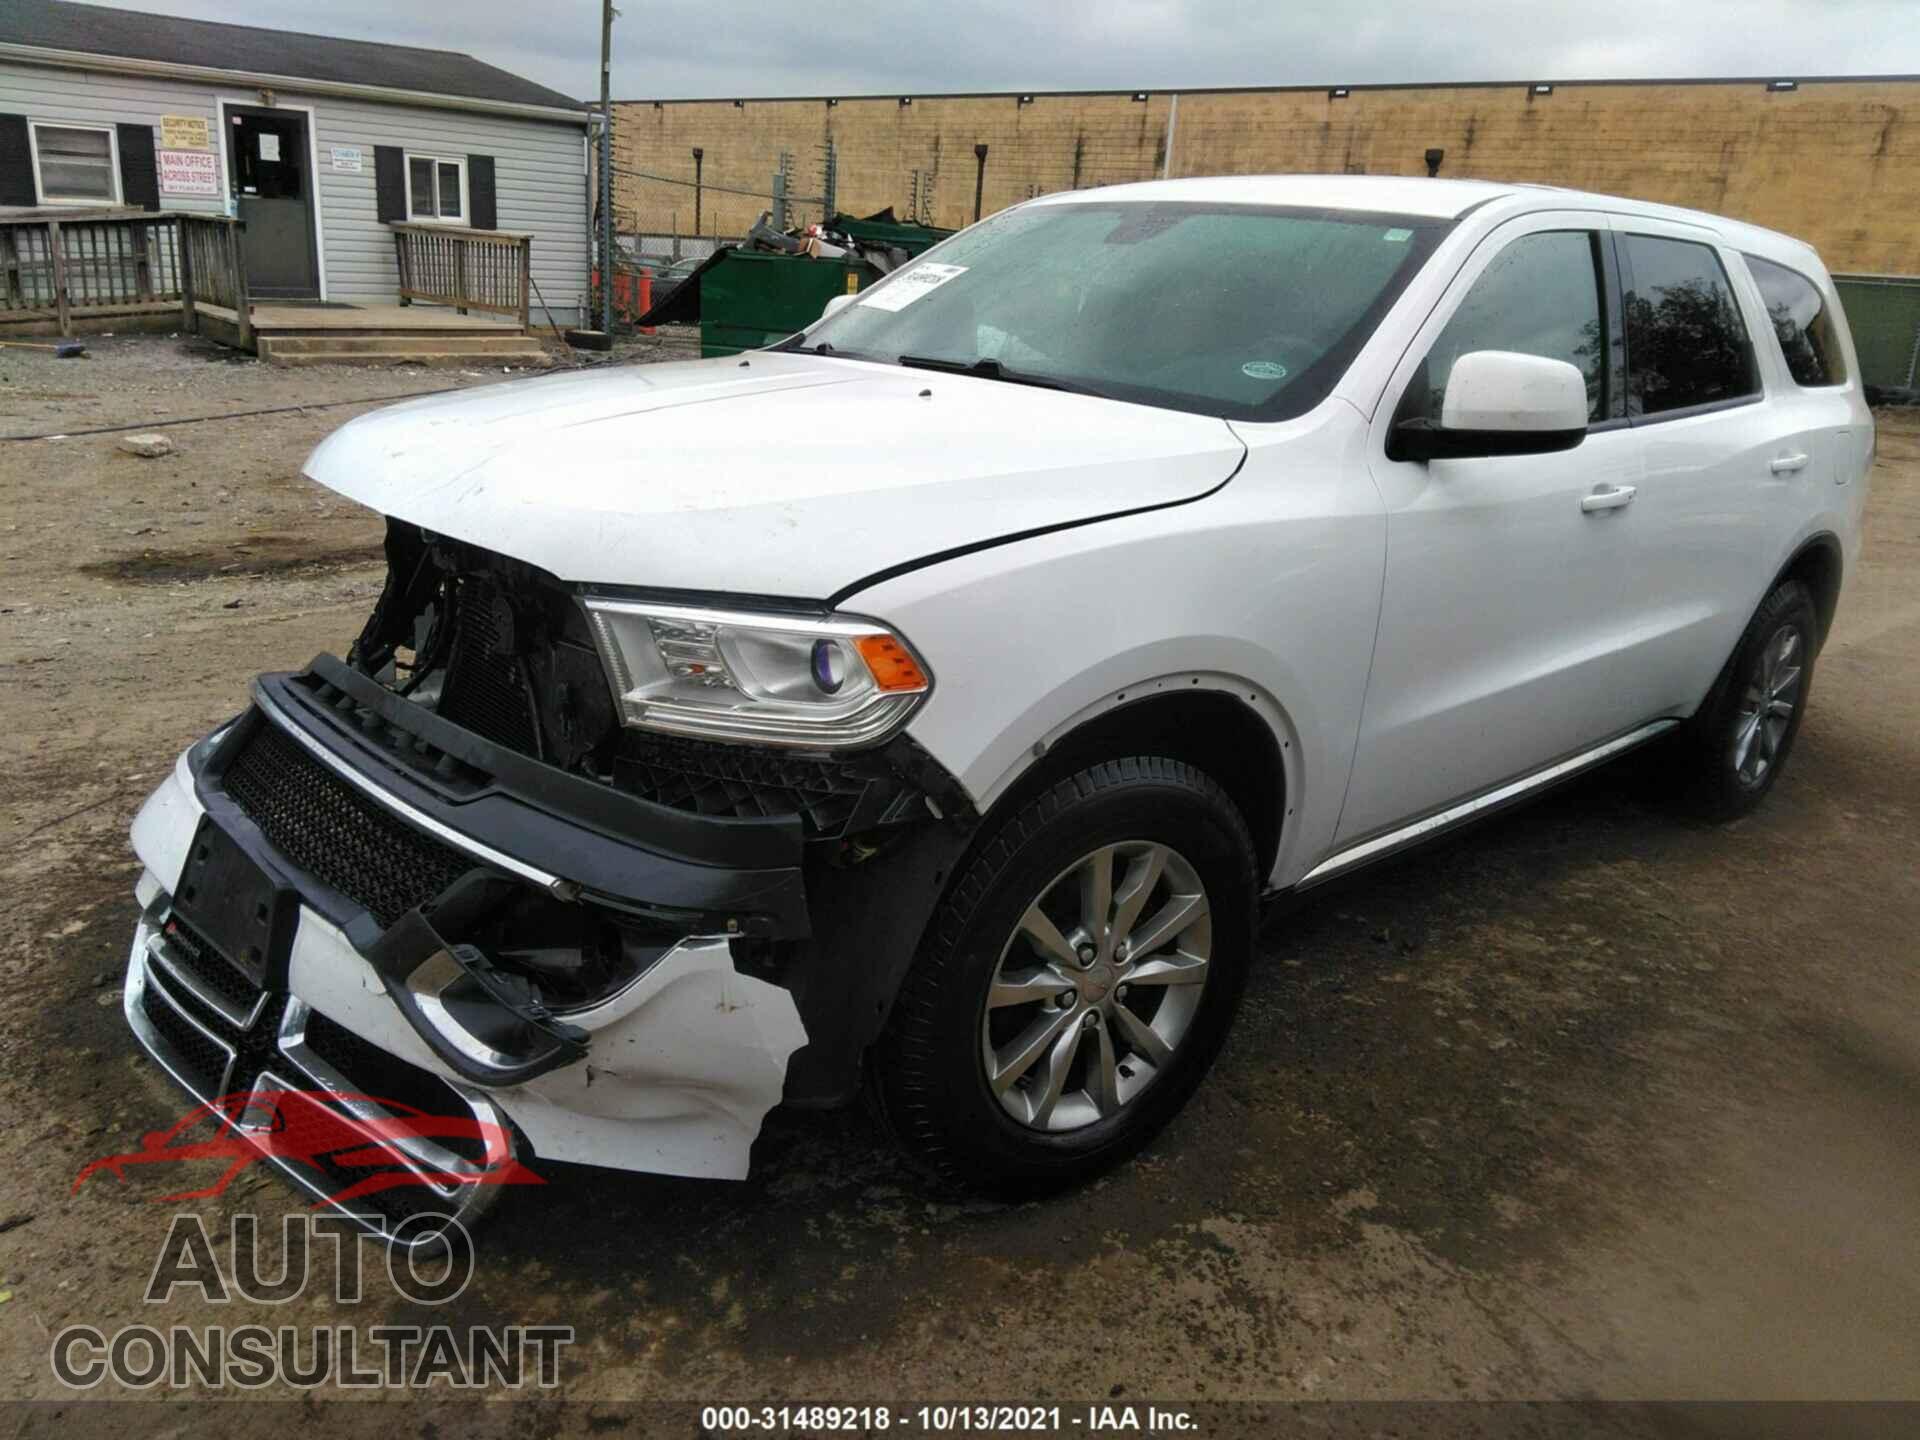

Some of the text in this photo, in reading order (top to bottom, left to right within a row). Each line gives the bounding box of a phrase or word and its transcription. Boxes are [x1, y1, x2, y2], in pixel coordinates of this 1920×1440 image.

[163, 154, 212, 168] MAIN OFFICE
[163, 169, 214, 184] ACROSS STREET
